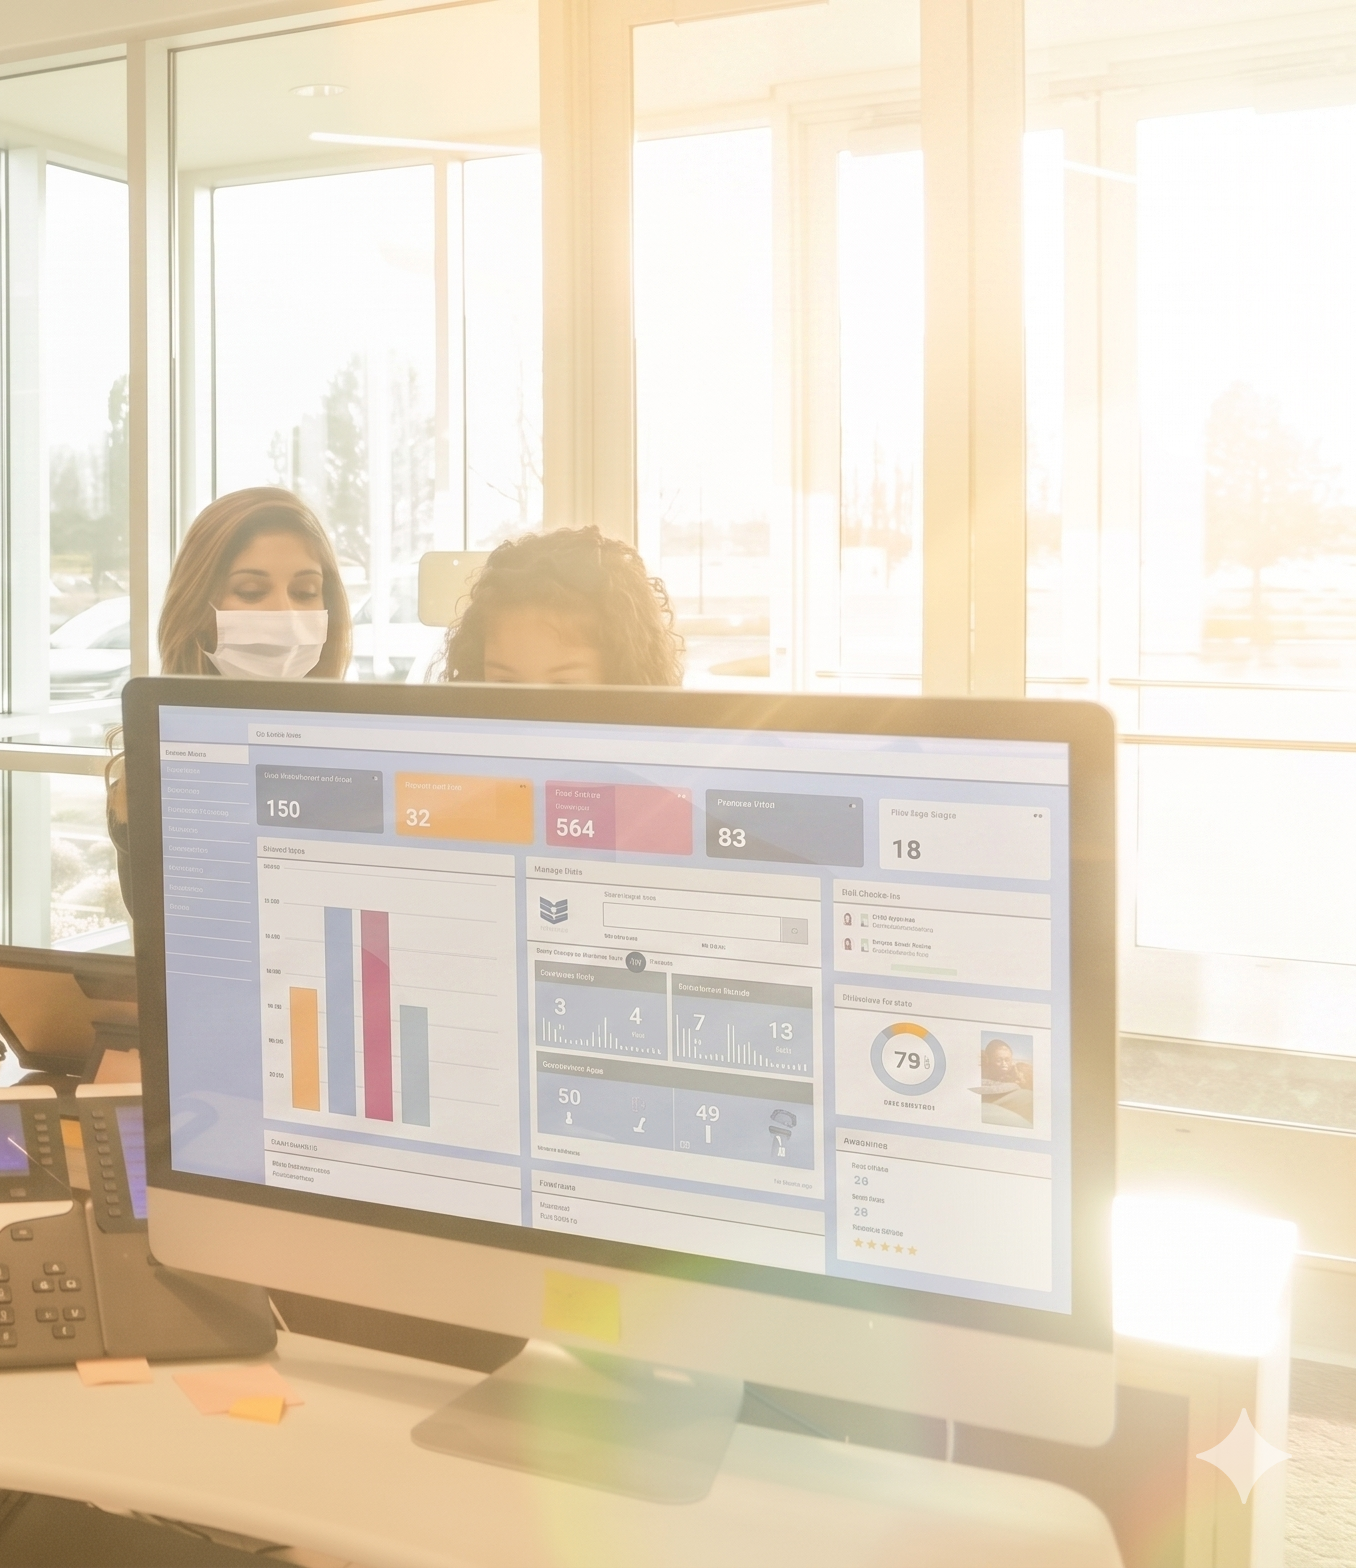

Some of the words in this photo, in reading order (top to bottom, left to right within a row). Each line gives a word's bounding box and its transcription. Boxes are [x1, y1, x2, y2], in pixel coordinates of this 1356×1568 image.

[266, 799, 301, 819] 150
[405, 808, 431, 828] 32
[555, 817, 595, 838] 564
[718, 827, 746, 848] 83
[892, 839, 922, 860] 18
[534, 865, 563, 876] Manage
[554, 997, 567, 1016] 3
[629, 1007, 643, 1025] 4
[693, 1013, 706, 1031] 7
[768, 1021, 794, 1041] 13
[894, 1050, 921, 1070] 79
[558, 1087, 582, 1106] 50
[695, 1104, 720, 1122] 49
